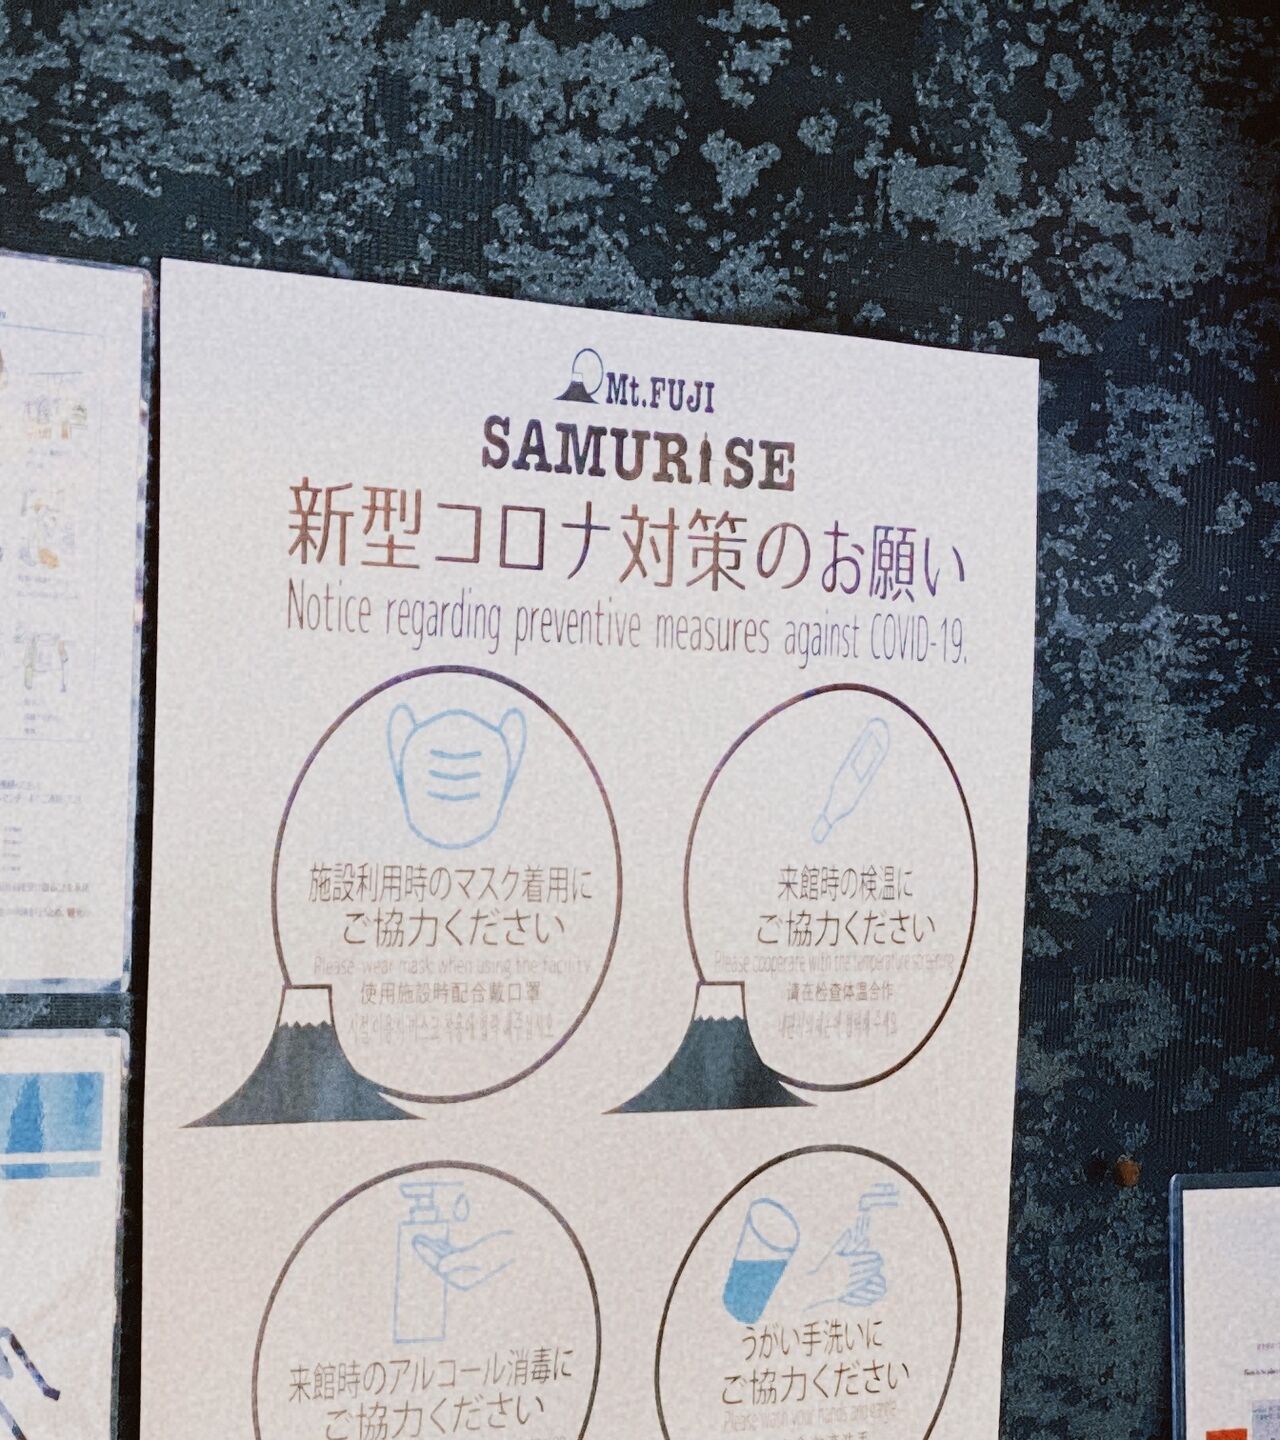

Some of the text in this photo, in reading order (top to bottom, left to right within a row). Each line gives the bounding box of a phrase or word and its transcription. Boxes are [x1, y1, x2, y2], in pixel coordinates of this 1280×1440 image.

[605, 371, 716, 414] Mt.FUJI
[287, 475, 966, 602] 新型コロナ対策のお願い
[287, 577, 970, 670] Notice regarding preventive measures against COVID-19.
[308, 863, 593, 904] 施設利用時のマスク着用に
[776, 864, 914, 902] 来館時の検温に
[342, 907, 566, 949] ご協力ください
[756, 909, 936, 948] ご協力ください
[313, 955, 355, 976] Please
[741, 1318, 884, 1362] うがい手洗いに
[289, 1345, 574, 1404] 来館時のアルコール消毒に
[721, 1358, 911, 1406] ご協力ください
